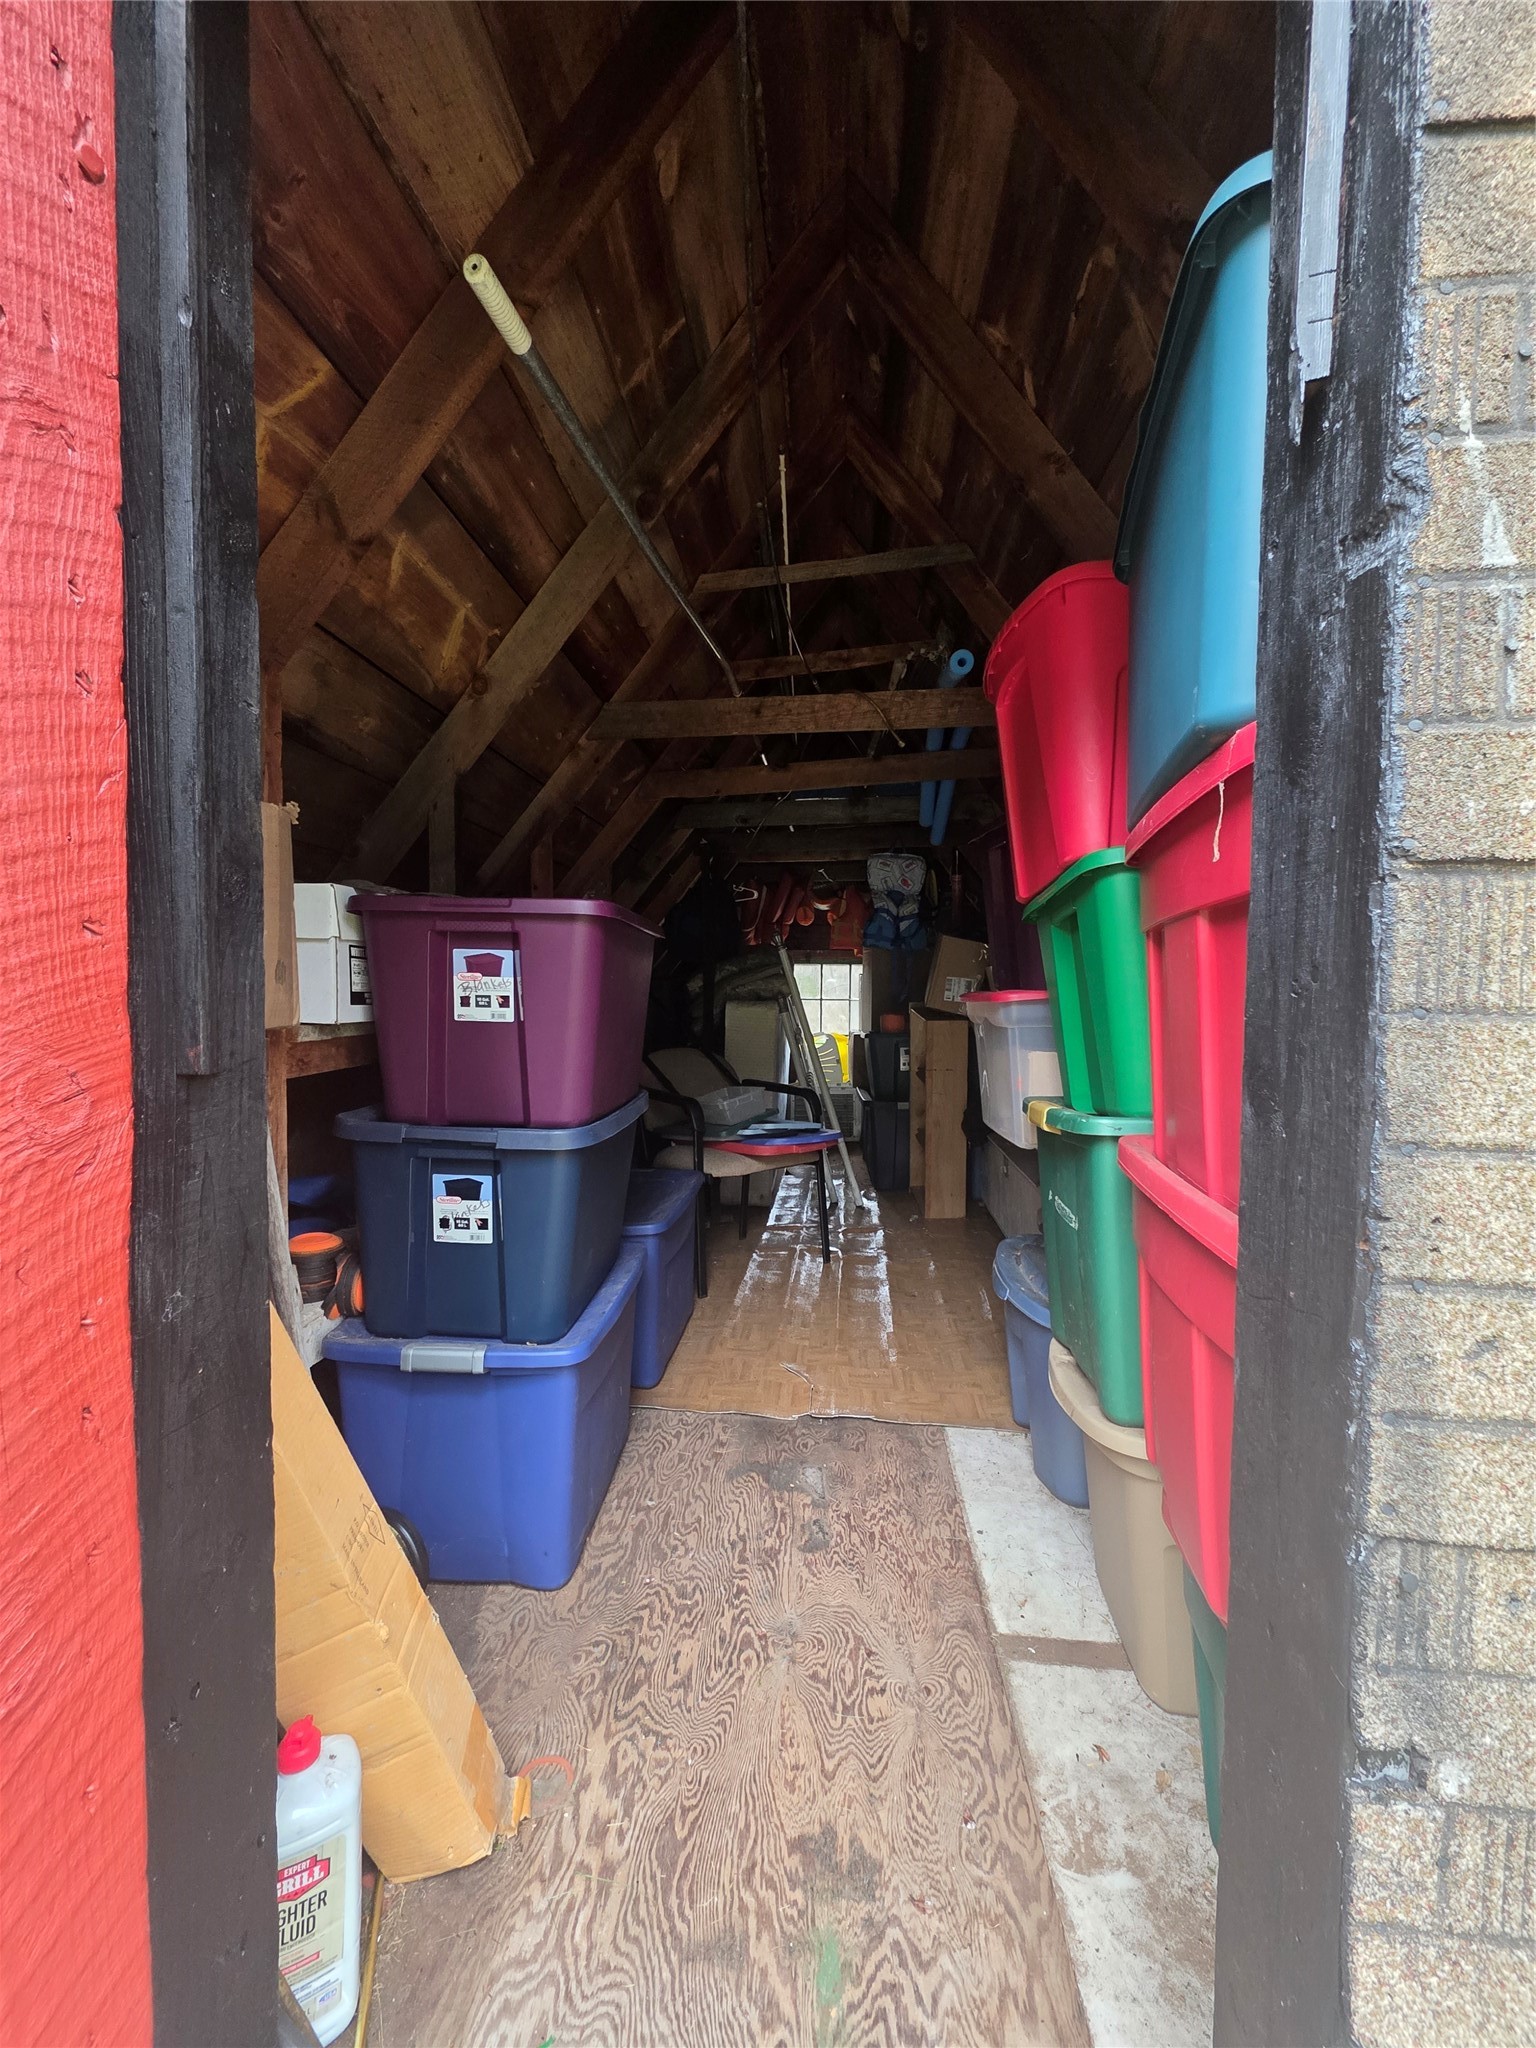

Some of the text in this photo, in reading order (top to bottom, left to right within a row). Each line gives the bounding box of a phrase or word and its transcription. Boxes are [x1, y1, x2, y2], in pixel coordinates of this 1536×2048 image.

[283, 1859, 311, 1878] EXPERT
[278, 1890, 328, 1928] GHTER
[278, 1914, 316, 1947] LUID
